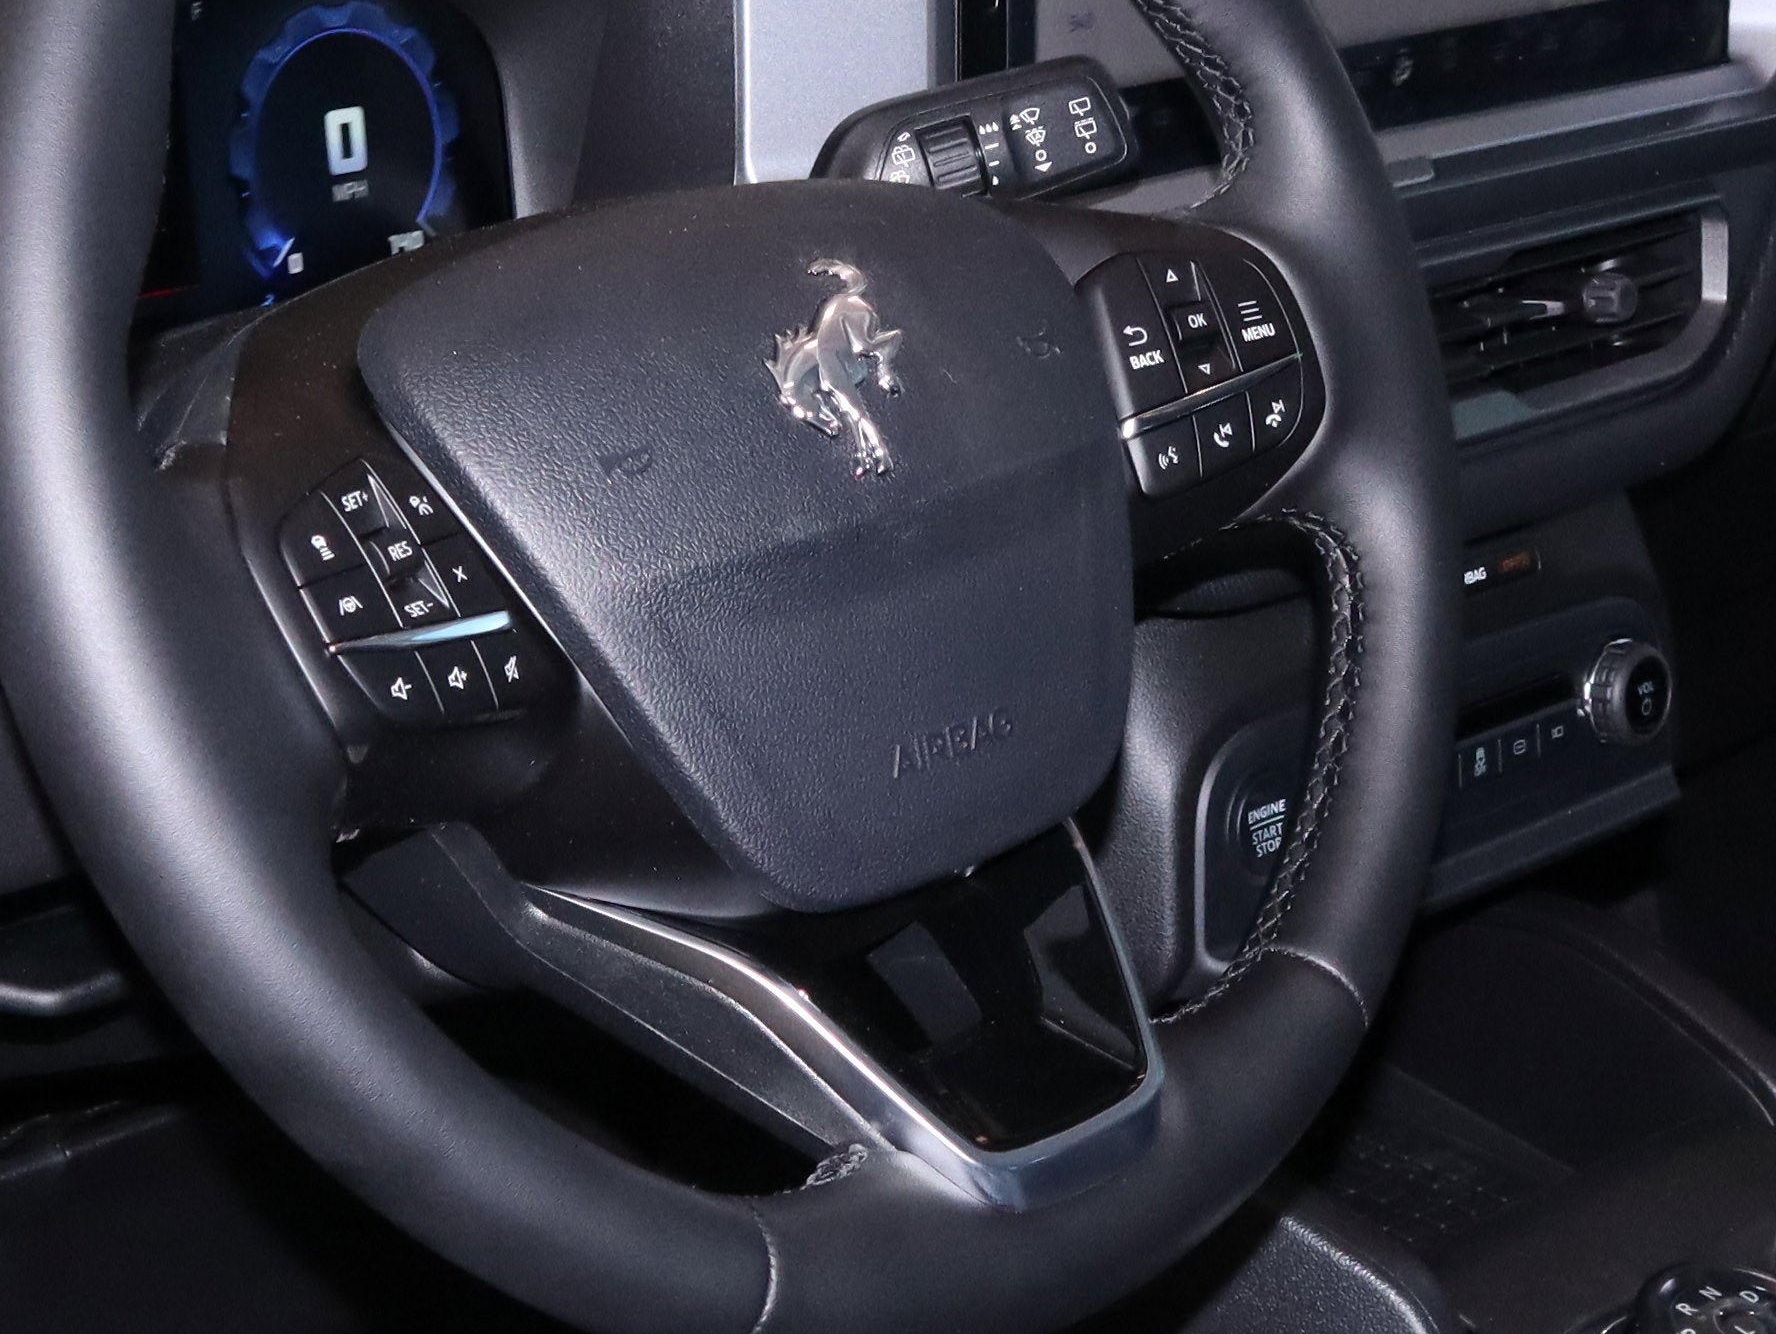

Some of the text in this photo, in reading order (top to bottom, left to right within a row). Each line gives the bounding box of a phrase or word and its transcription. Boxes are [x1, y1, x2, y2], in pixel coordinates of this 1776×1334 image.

[324, 106, 369, 177] 0
[1187, 313, 1207, 329] OK
[1241, 323, 1276, 343] MENU
[1129, 350, 1165, 370] BACK
[341, 492, 369, 513] SET+
[388, 540, 413, 562] RES
[1637, 681, 1655, 696] VOL
[1247, 798, 1287, 825] ENGINE
[1252, 822, 1283, 846] START
